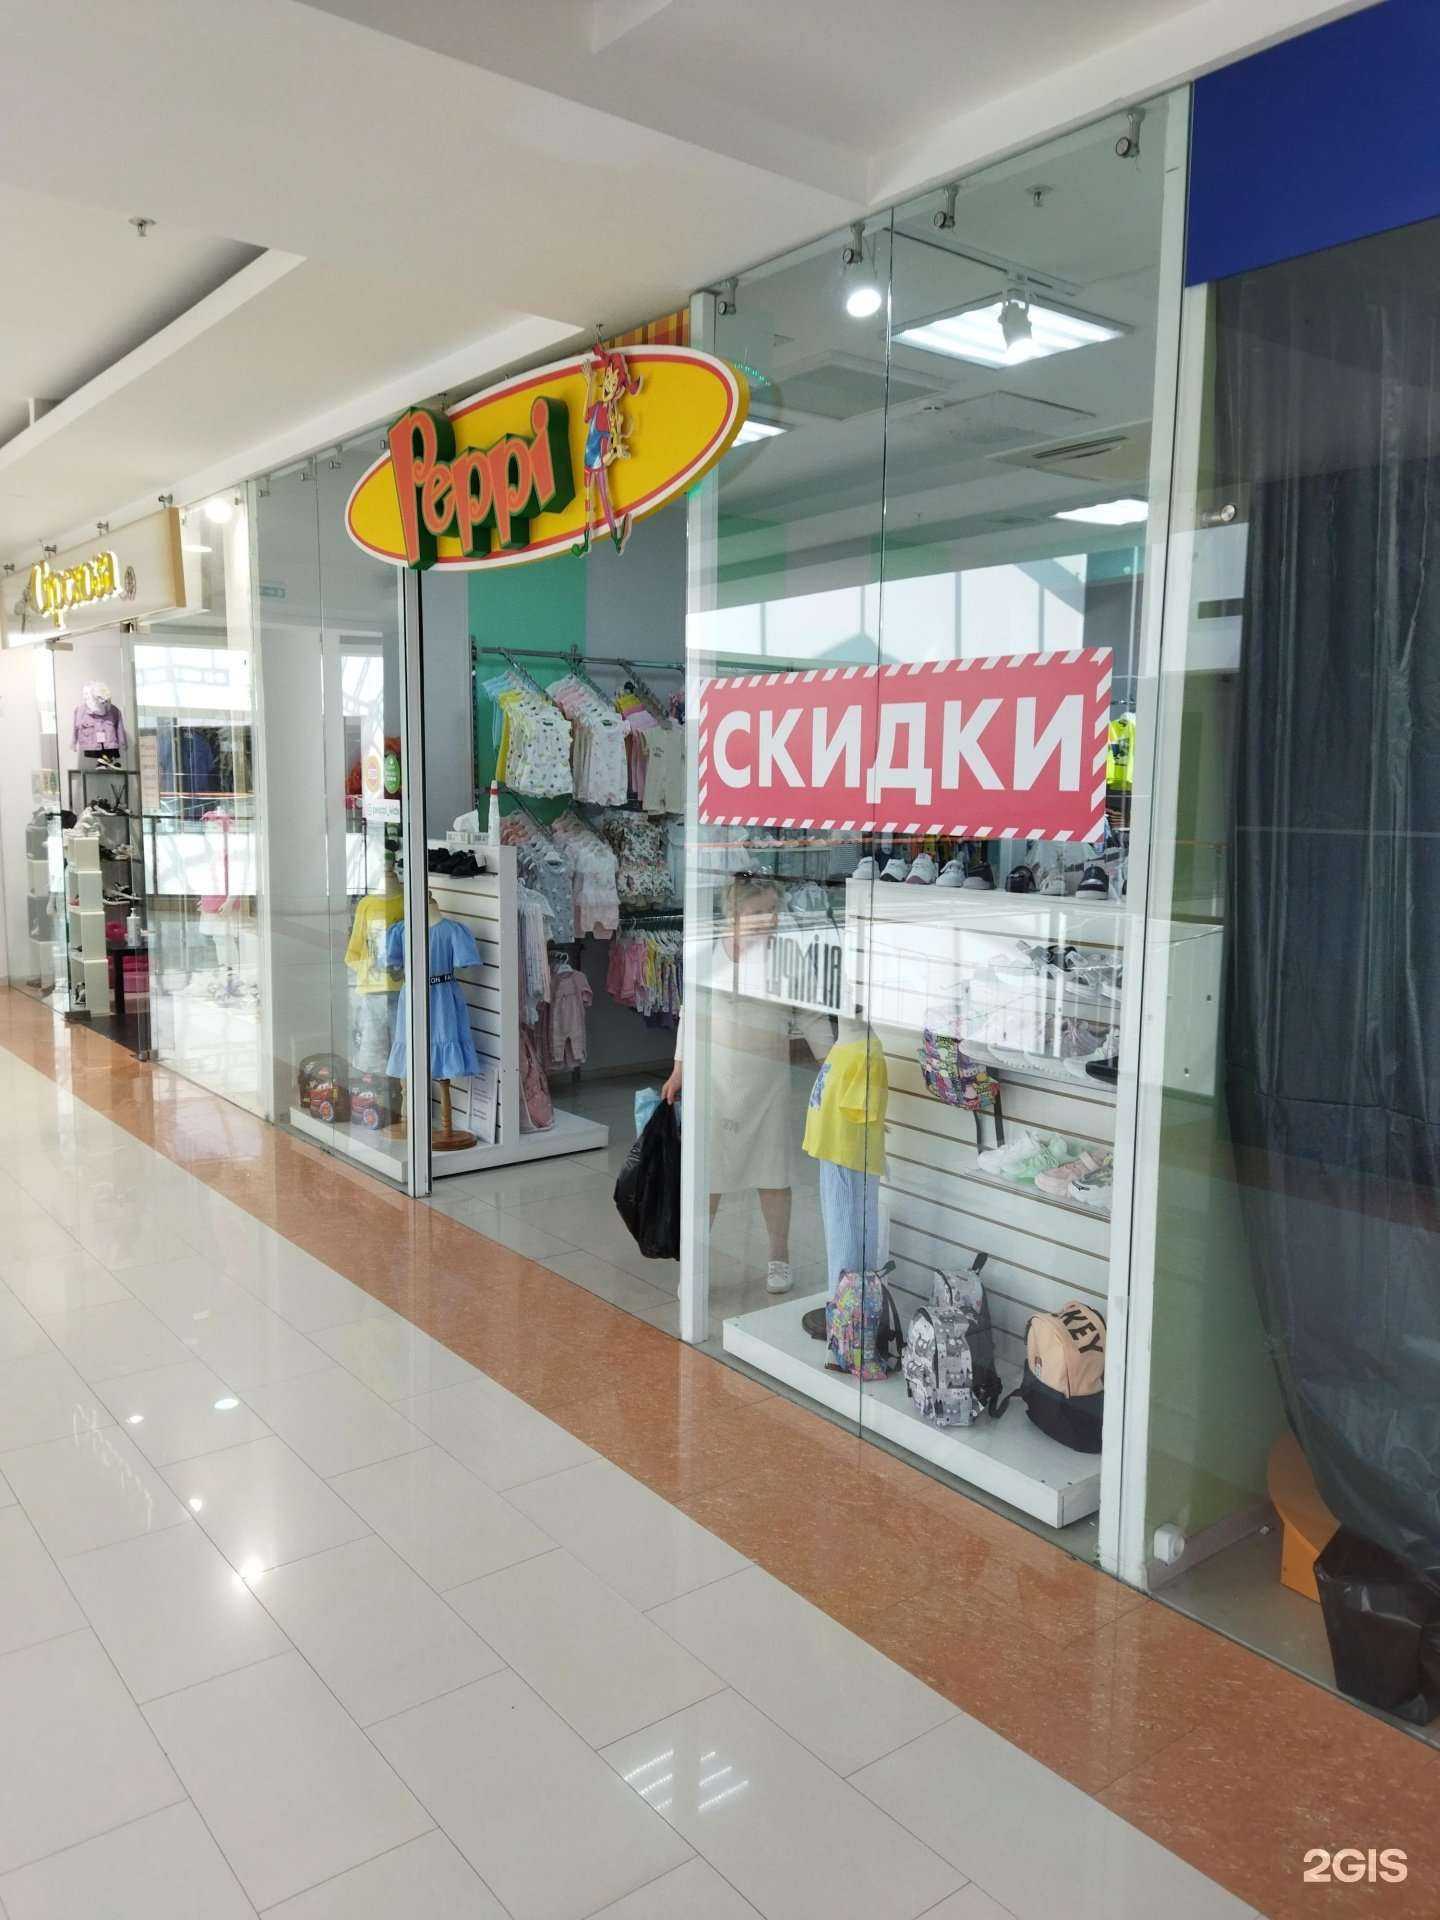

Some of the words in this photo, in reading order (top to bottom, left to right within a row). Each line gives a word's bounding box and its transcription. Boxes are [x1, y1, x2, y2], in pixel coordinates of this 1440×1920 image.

[388, 396, 571, 570] Peppi
[712, 694, 1084, 805] СКИДКИ
[1061, 1309, 1104, 1354] KEY
